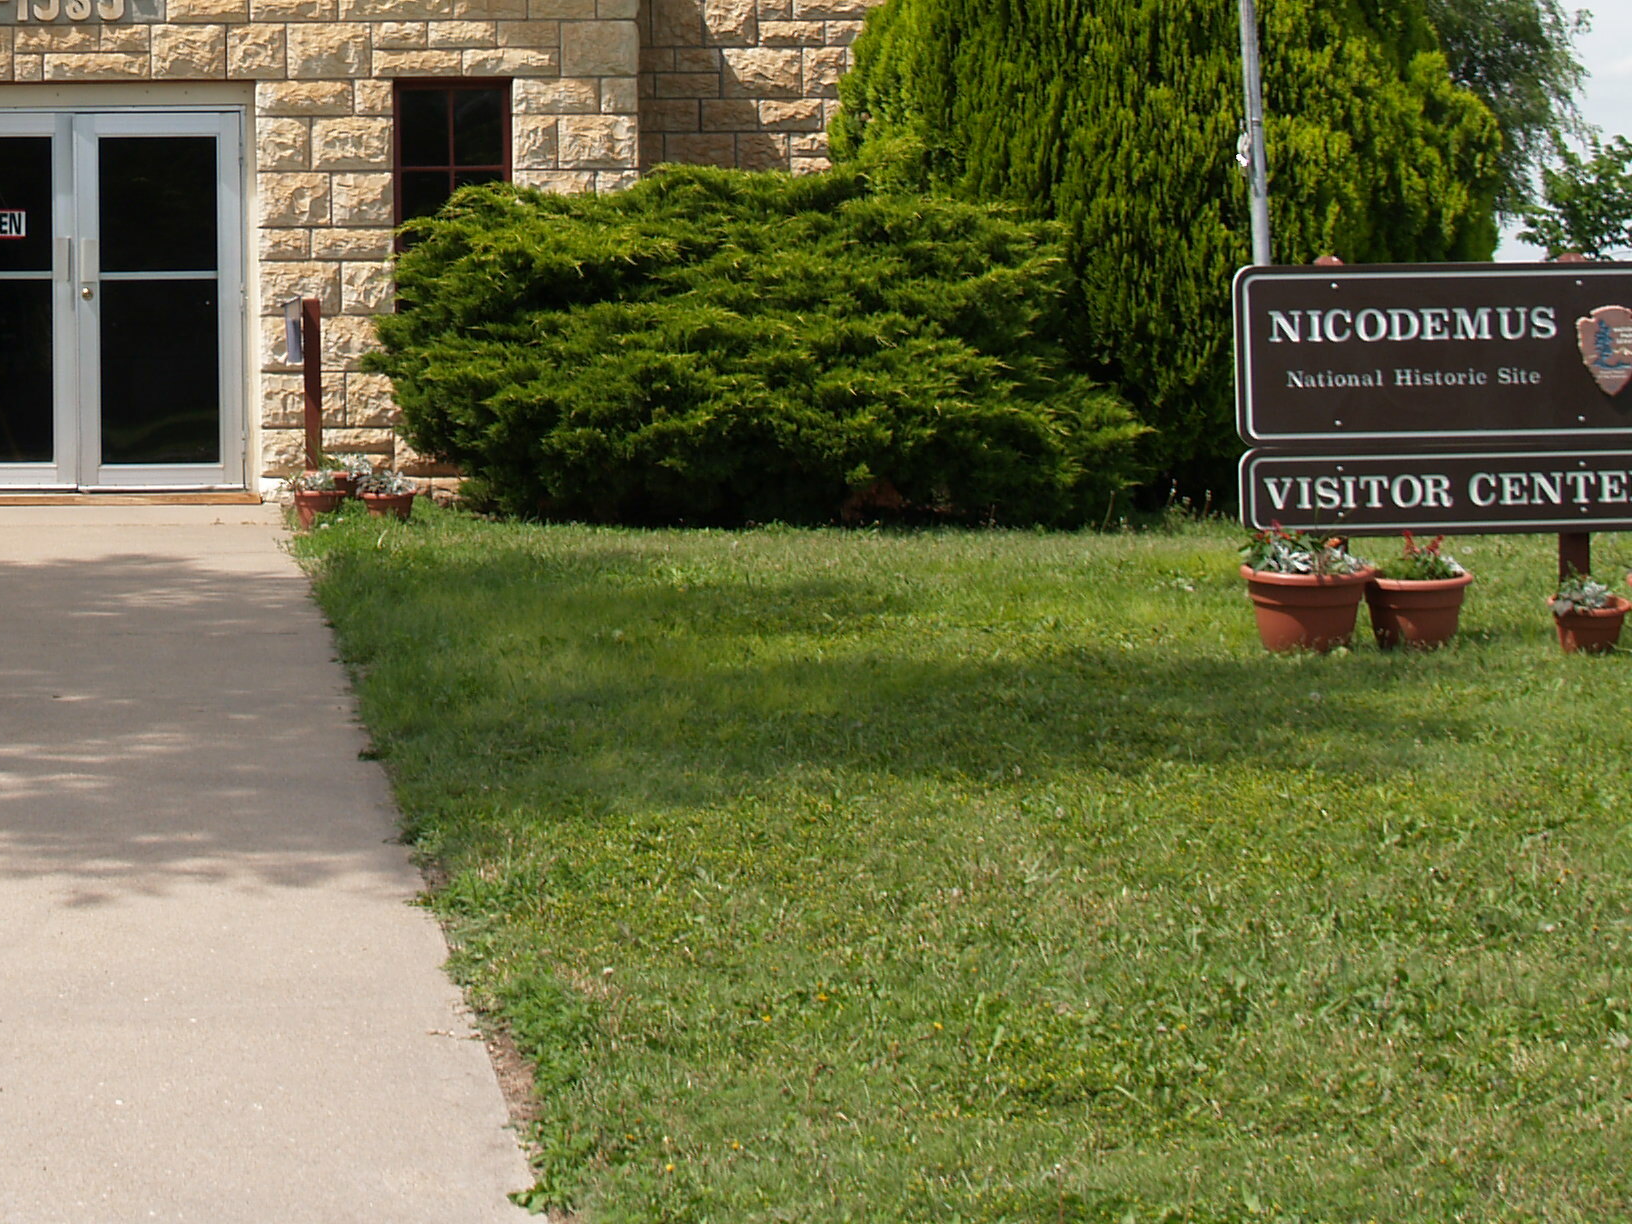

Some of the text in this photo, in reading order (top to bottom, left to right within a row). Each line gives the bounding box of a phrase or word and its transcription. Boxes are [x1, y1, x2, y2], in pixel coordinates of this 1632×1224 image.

[1268, 306, 1558, 343] NICODEMUS
[1286, 366, 1542, 389] National Historic Site
[1263, 470, 1632, 511] VISITOR CENTE
